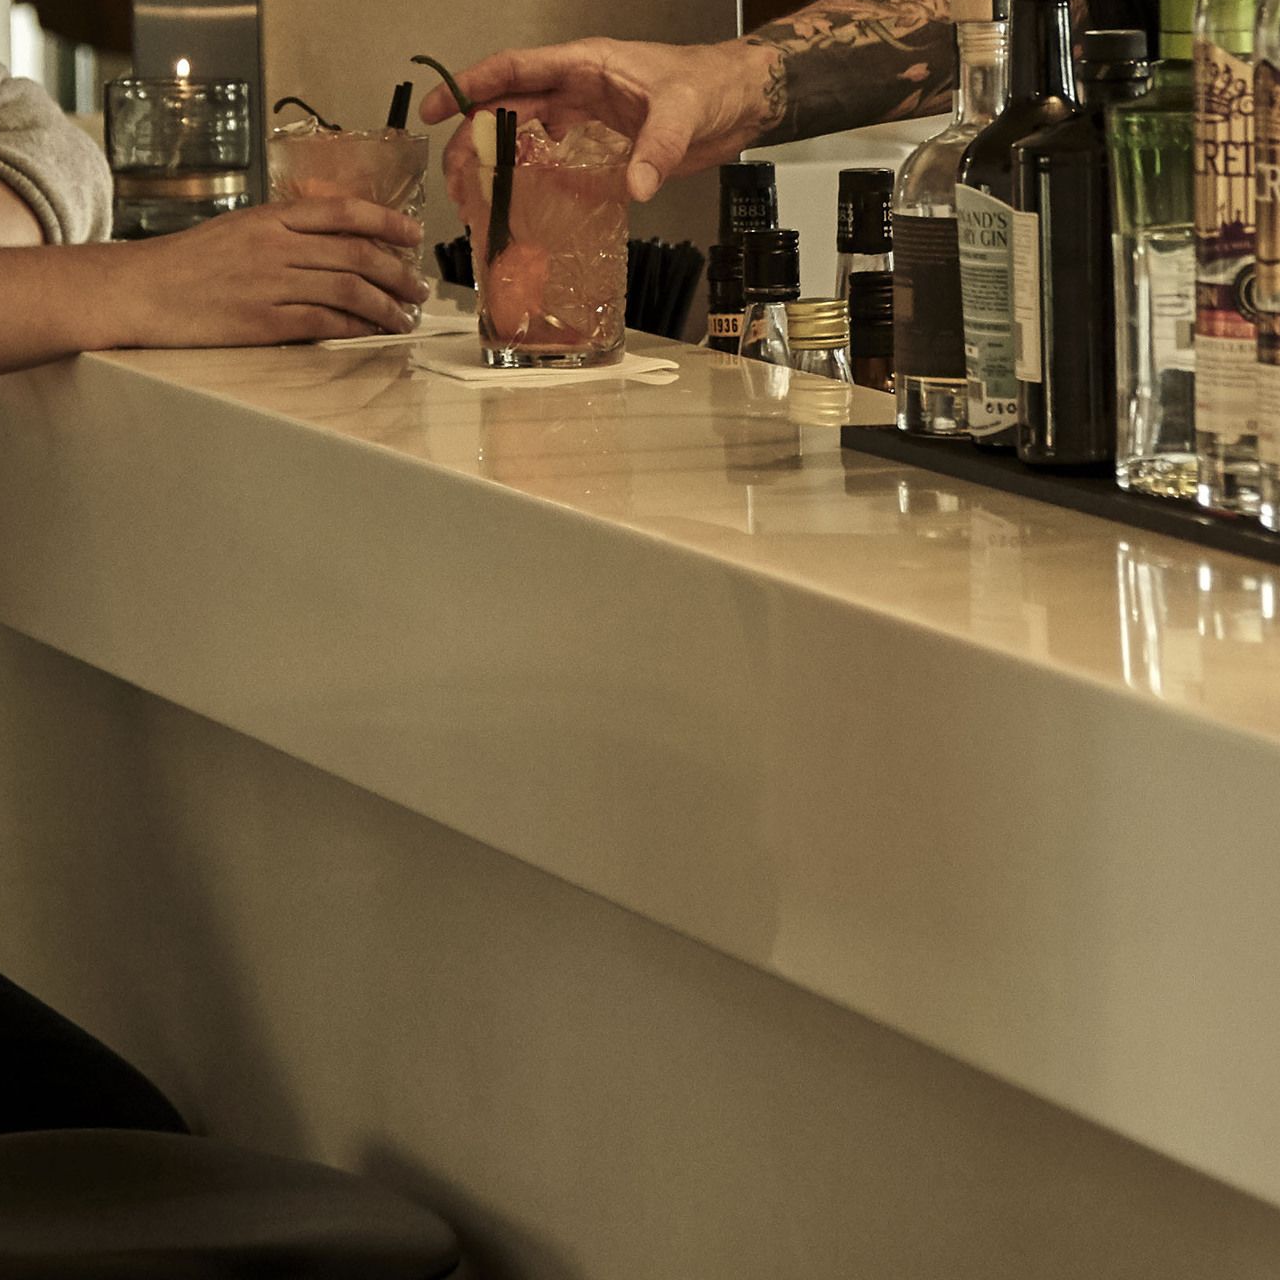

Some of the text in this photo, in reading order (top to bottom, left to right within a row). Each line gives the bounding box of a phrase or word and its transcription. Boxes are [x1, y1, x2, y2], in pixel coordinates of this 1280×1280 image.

[731, 204, 767, 217] 1883
[980, 229, 1008, 247] GIN
[712, 318, 738, 333] 1936
